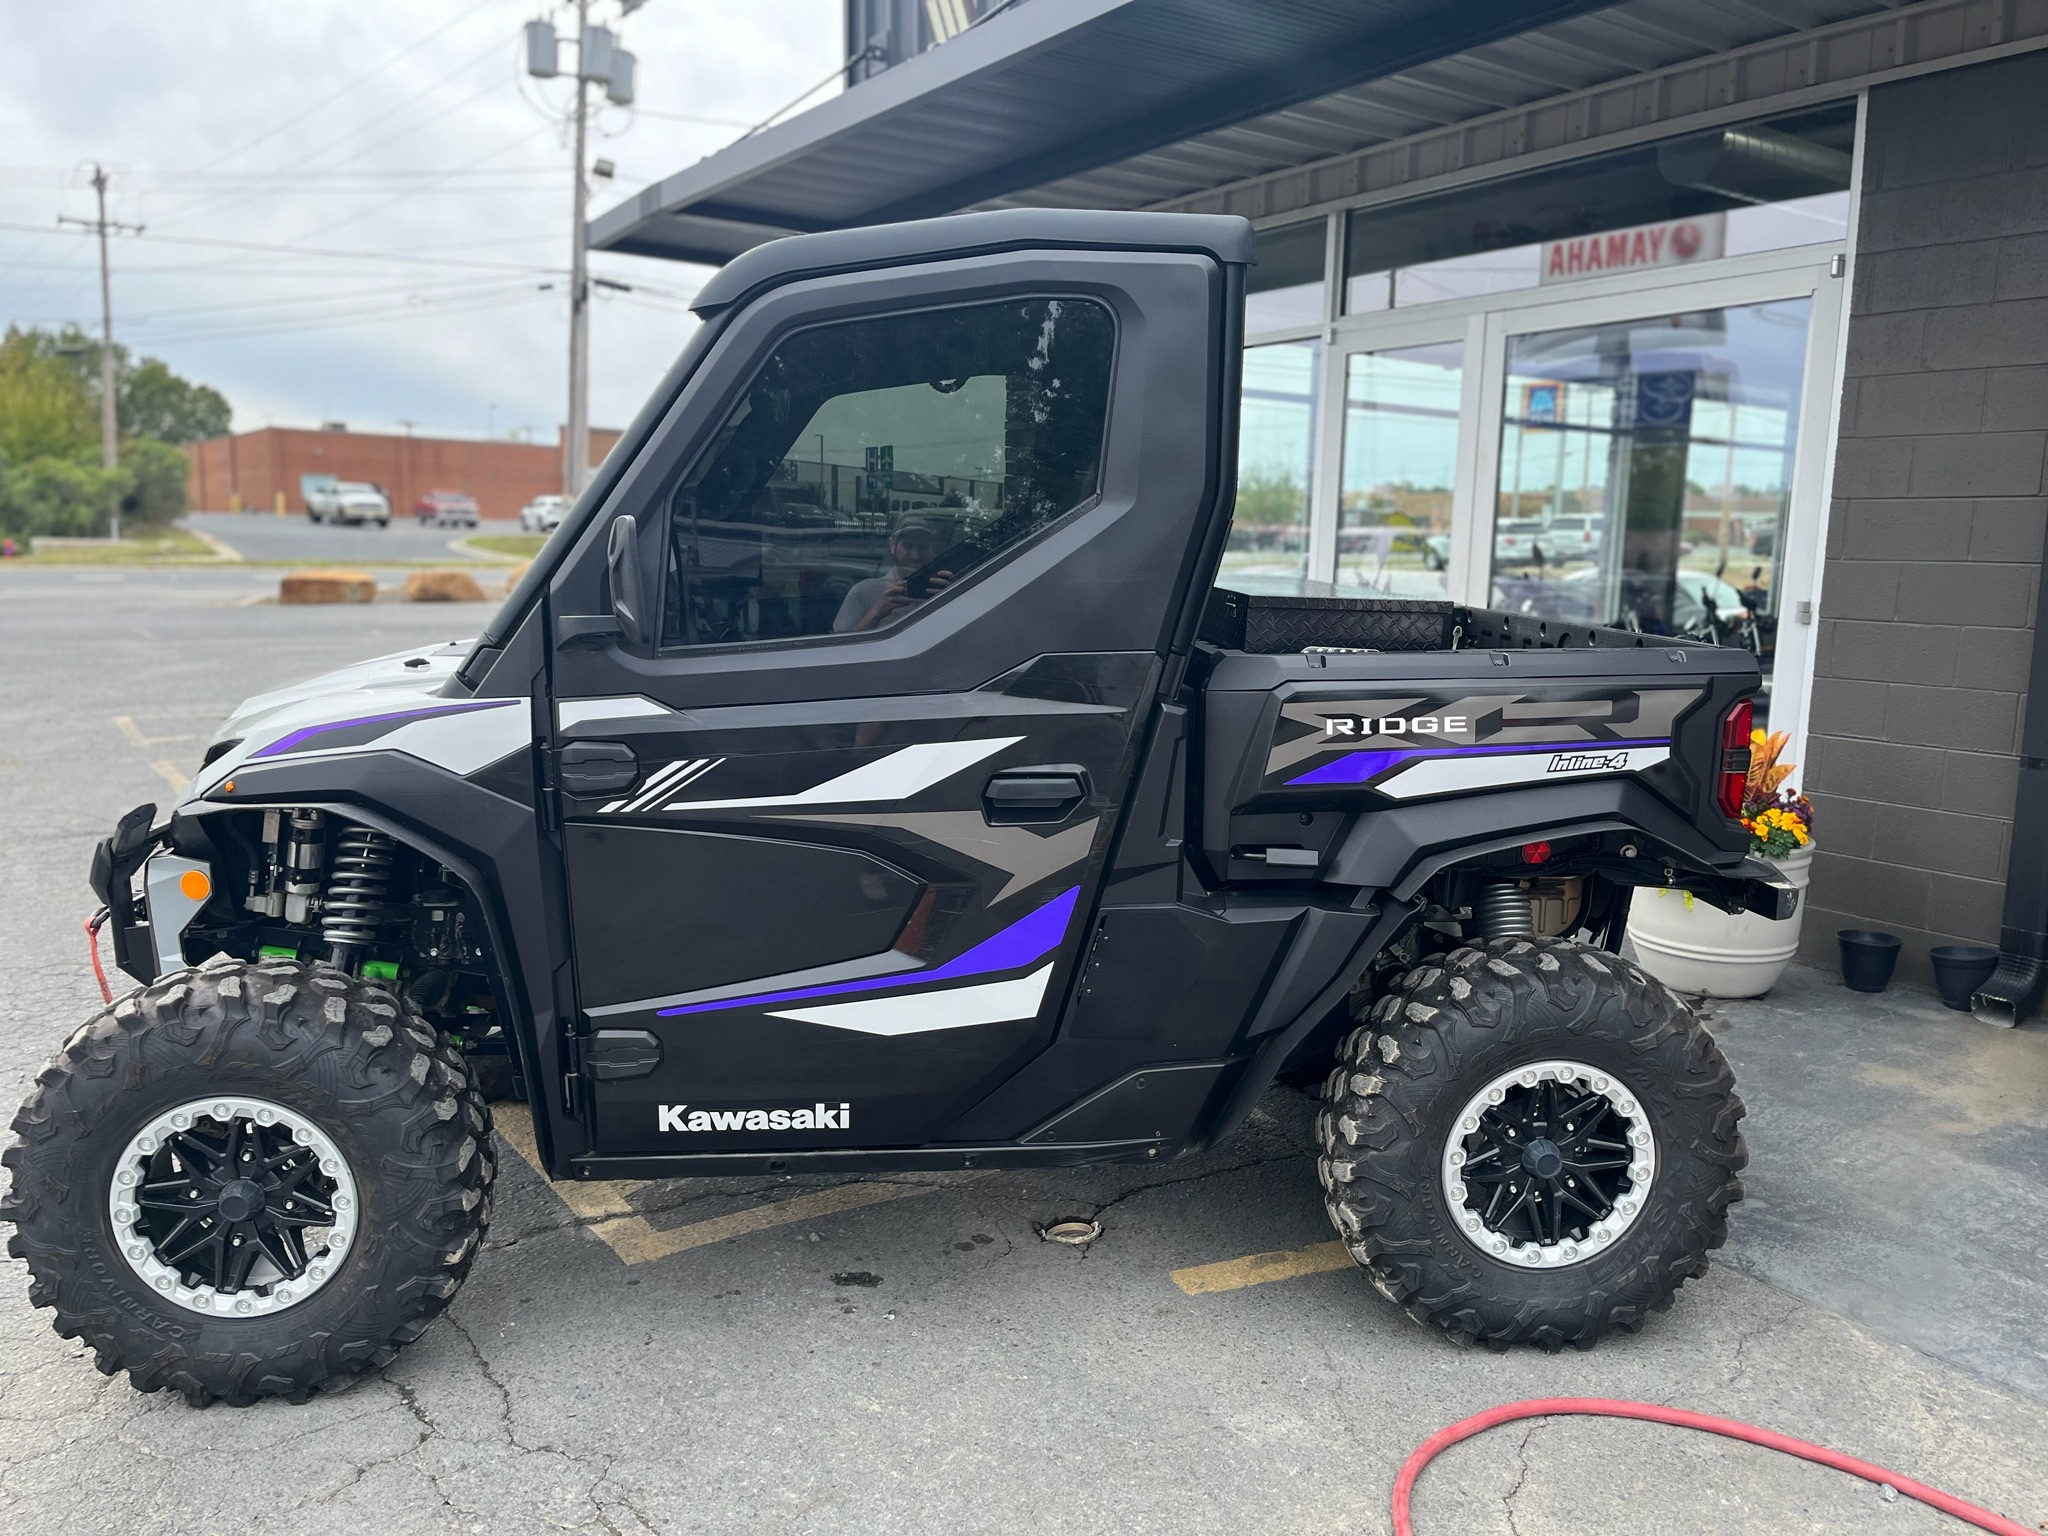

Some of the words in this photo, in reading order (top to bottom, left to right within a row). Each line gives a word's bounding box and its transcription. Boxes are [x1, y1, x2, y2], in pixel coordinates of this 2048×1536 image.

[1325, 715, 1469, 736] RIDGE
[1546, 752, 1629, 773] Inline-4
[658, 1102, 851, 1132] Kawasaki
[79, 1229, 187, 1339] CARNIVORE
